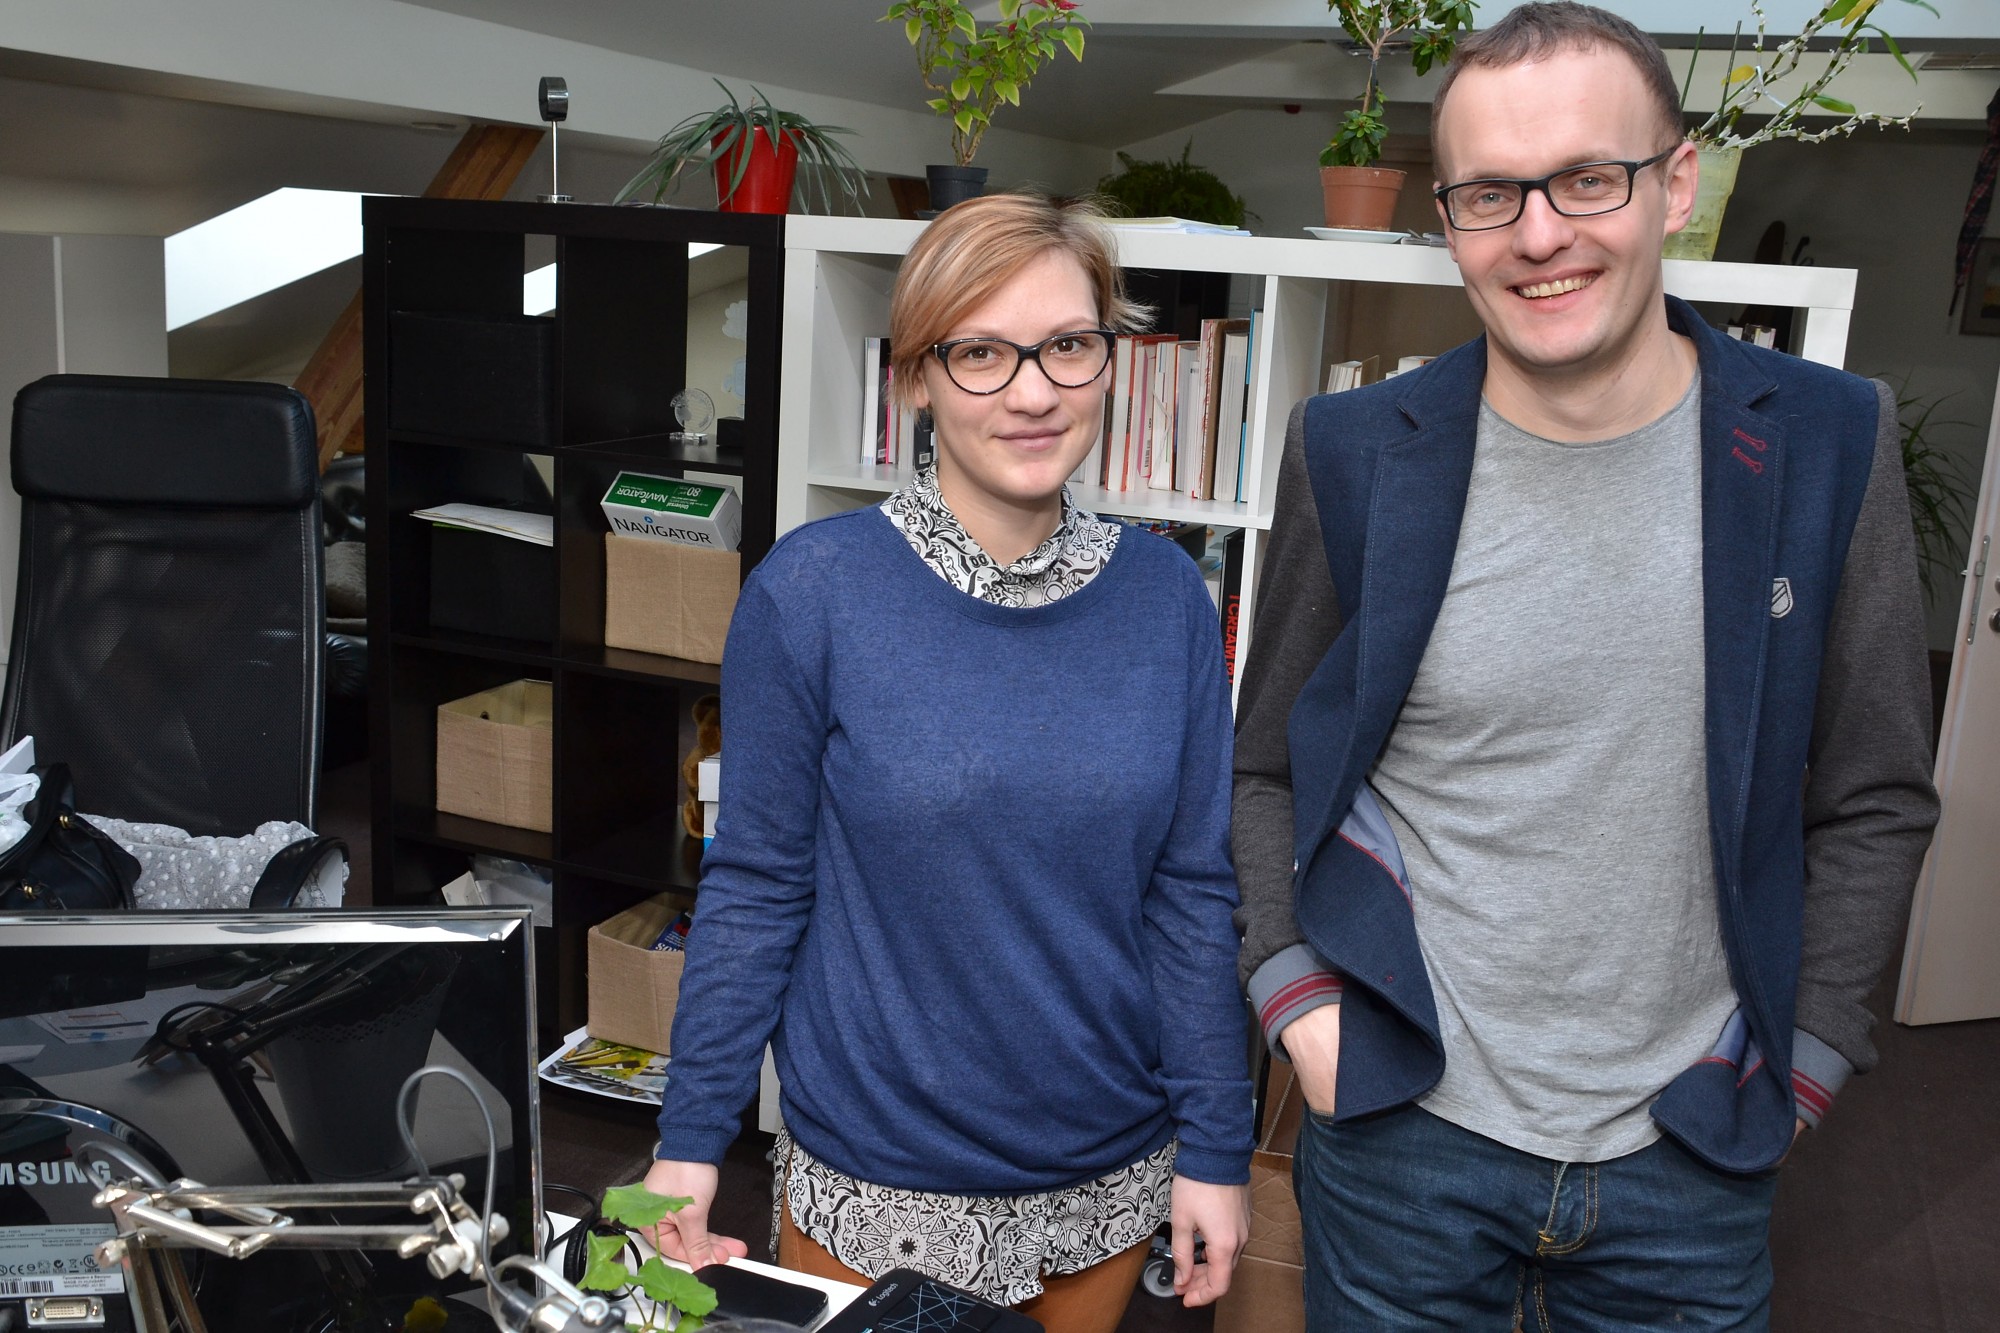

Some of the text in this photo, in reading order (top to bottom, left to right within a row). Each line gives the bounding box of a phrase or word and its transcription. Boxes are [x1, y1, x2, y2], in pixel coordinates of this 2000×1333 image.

[616, 487, 669, 503] NAVIGATOR
[687, 486, 702, 497] 80
[613, 517, 712, 544] NAVIGATOR
[1225, 603, 1240, 659] CREAM
[876, 1282, 899, 1301] Logitech
